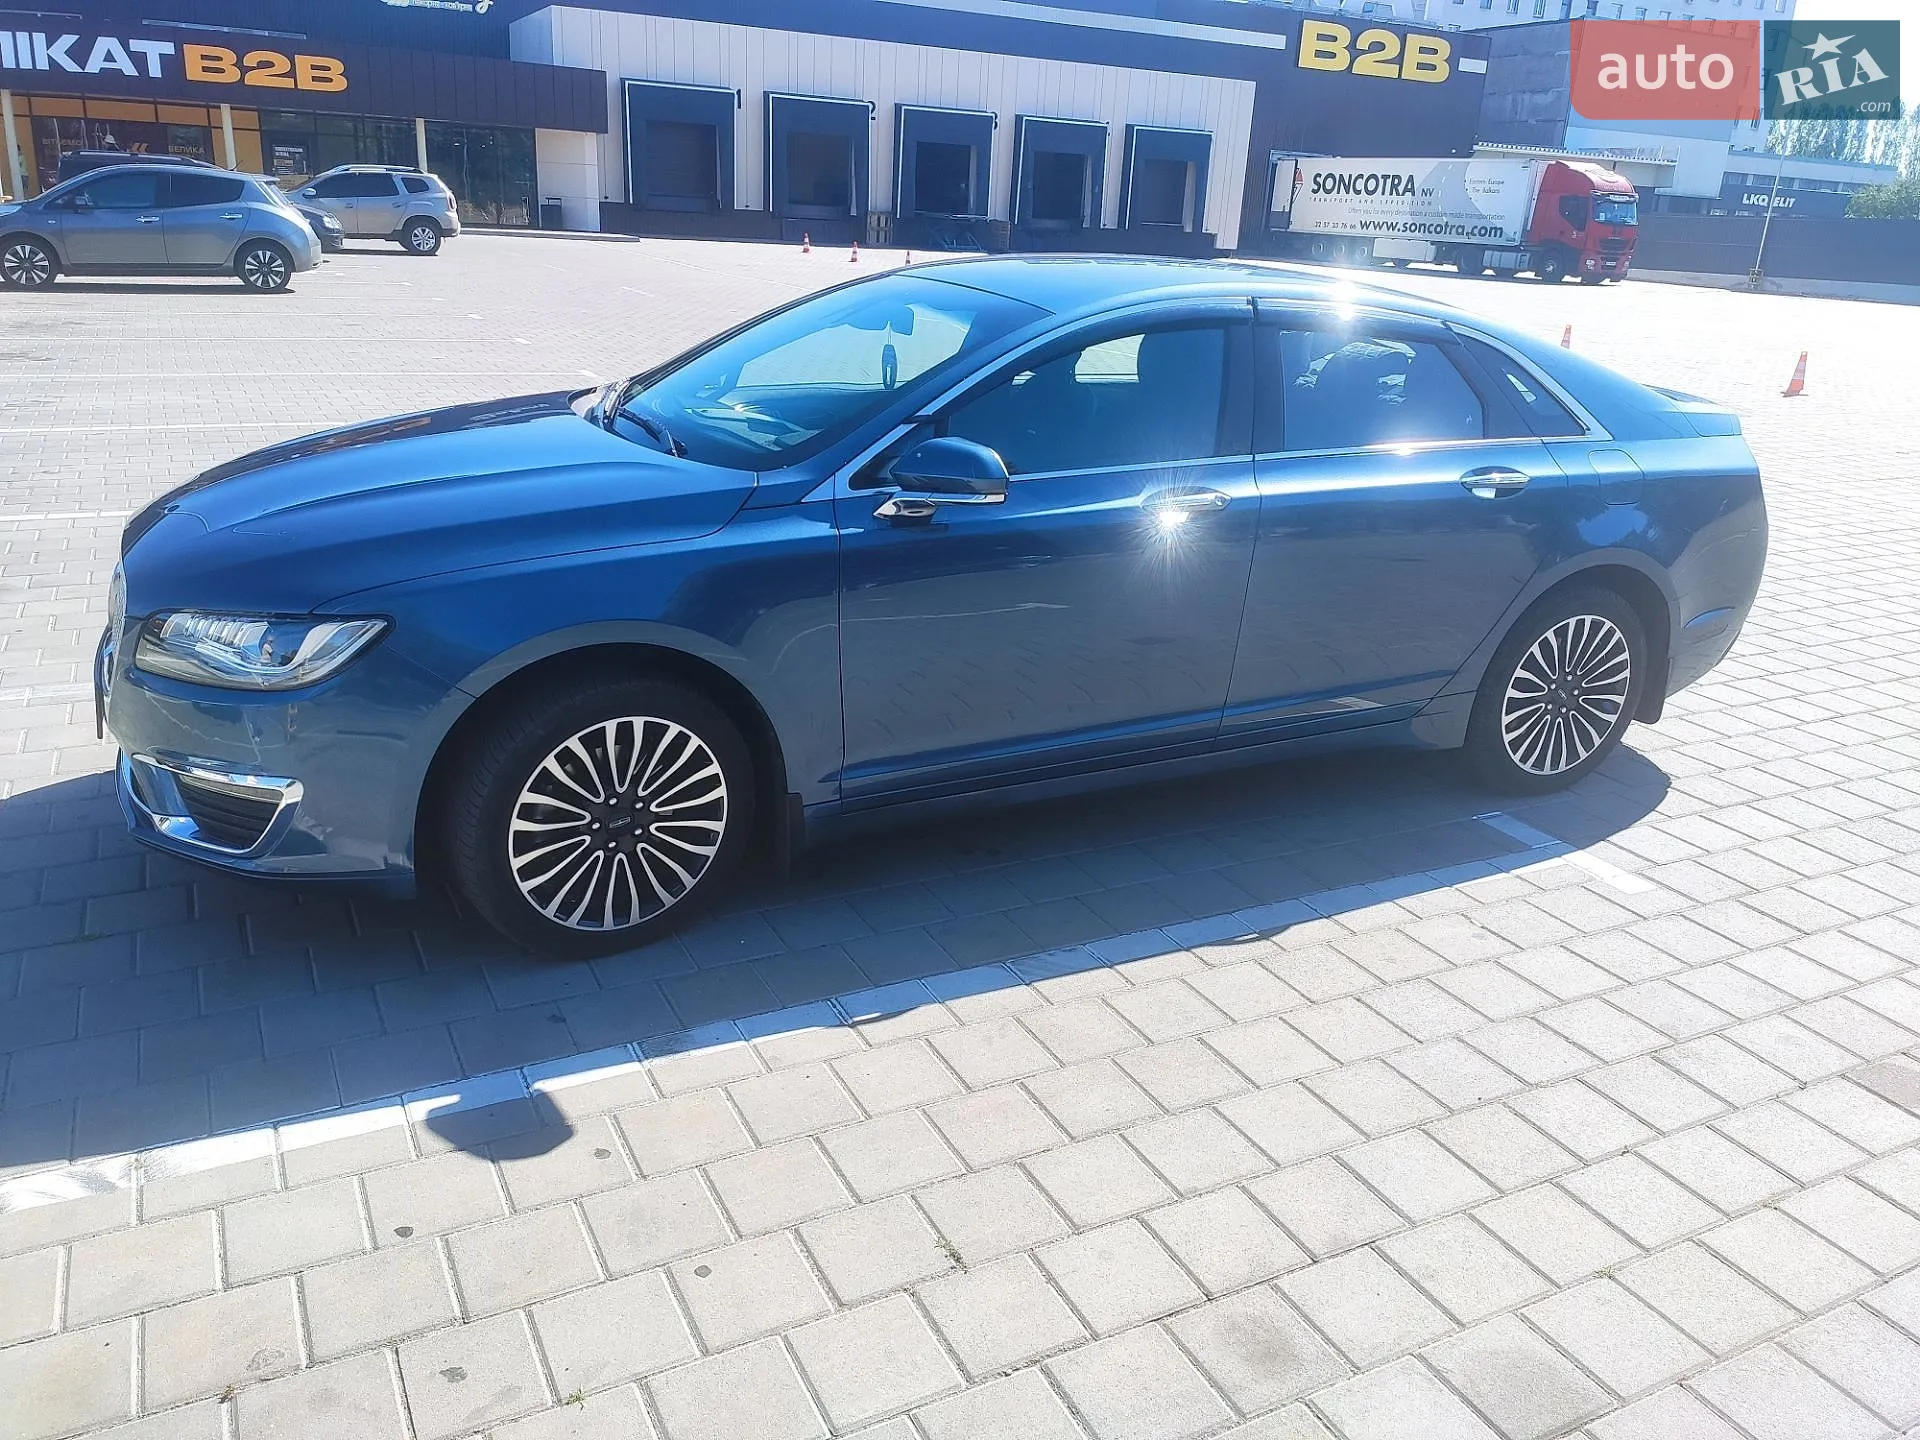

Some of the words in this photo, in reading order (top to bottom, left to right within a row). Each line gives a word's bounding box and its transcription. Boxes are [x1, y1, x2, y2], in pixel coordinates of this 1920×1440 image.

[1299, 20, 1451, 83] B2B
[183, 43, 349, 92] B2B
[1311, 173, 1416, 197] SONCOTRA
[1421, 187, 1435, 197] NV
[1742, 193, 1769, 207] LKQ
[1773, 196, 1796, 208] ELIT
[1360, 220, 1504, 239] www.soncotra.com
